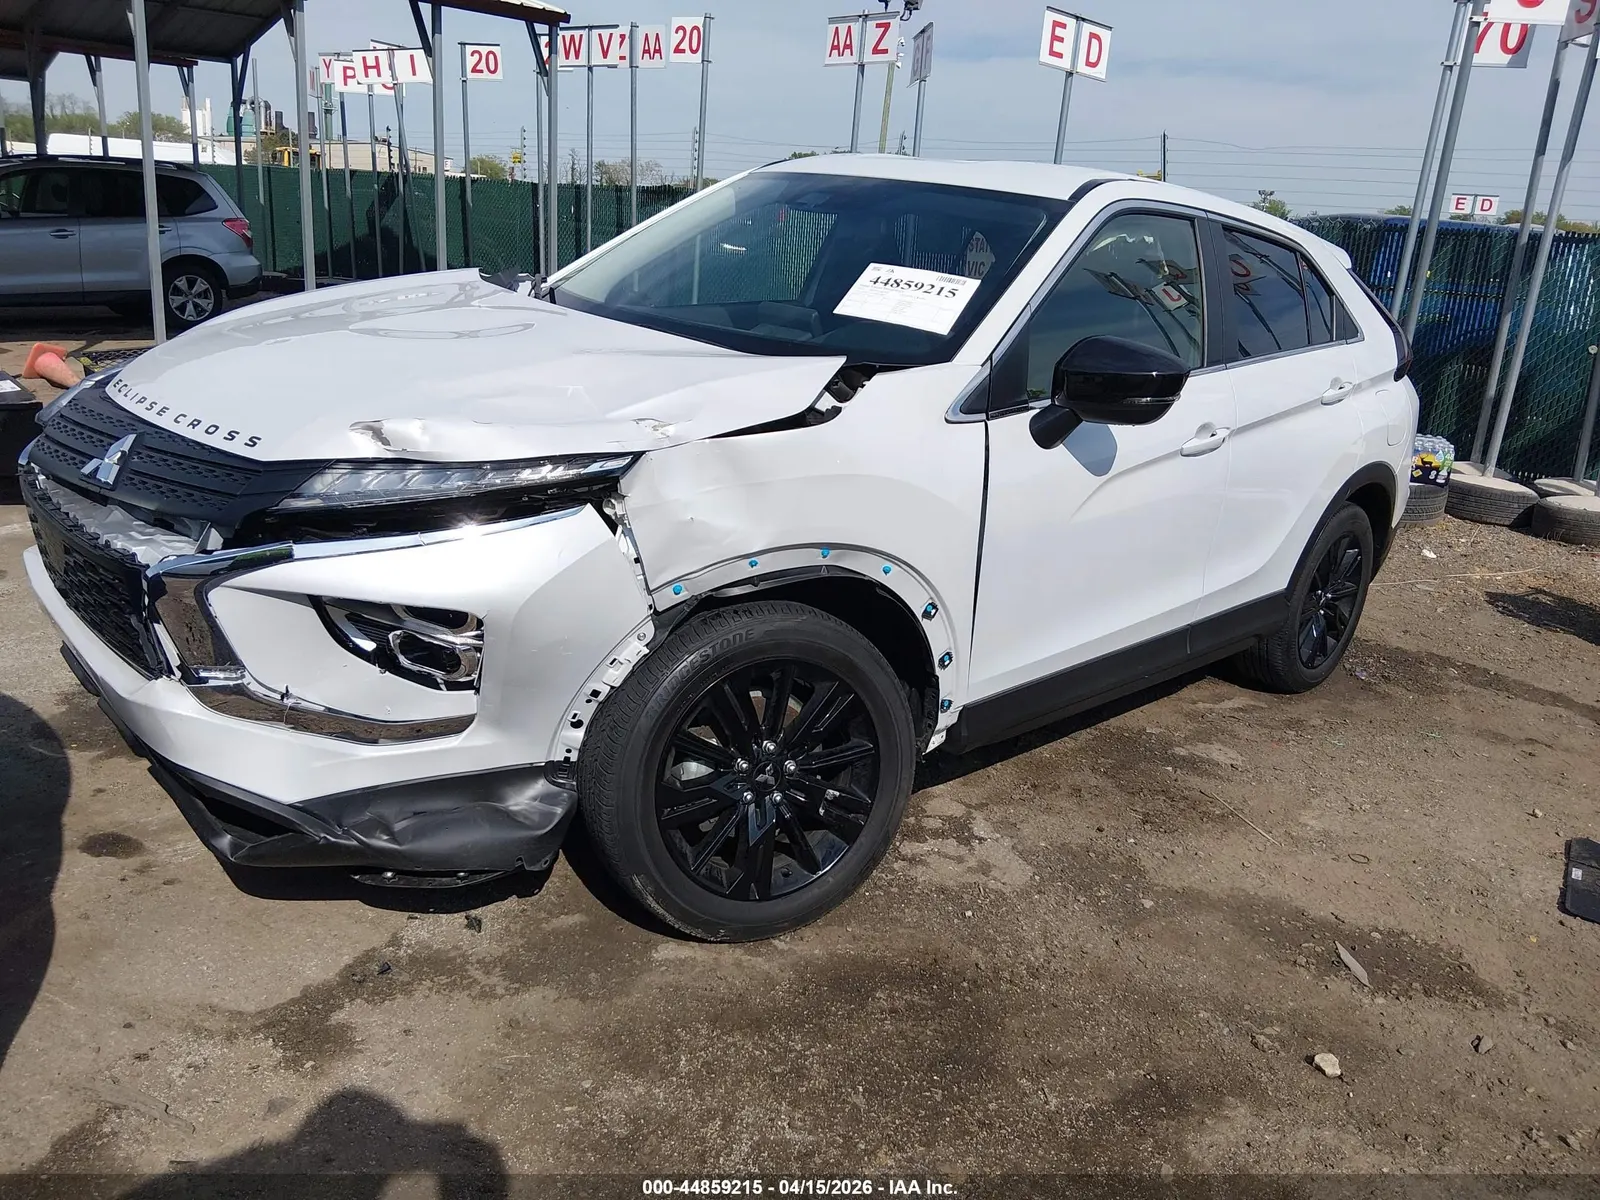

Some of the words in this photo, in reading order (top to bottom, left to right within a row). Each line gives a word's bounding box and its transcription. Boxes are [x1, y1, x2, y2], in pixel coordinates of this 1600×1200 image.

[561, 34, 584, 60] W
[597, 32, 614, 60] V
[641, 32, 663, 61] AA
[672, 25, 702, 55] 20
[828, 24, 854, 58] AA
[871, 22, 891, 55] Z
[1048, 19, 1067, 59] E
[1085, 31, 1103, 69] D
[322, 58, 332, 79] Y
[361, 55, 382, 78] H
[409, 53, 417, 77] I
[470, 49, 499, 75] 20
[342, 65, 357, 87] P
[1454, 197, 1467, 211] E
[1479, 198, 1493, 212] D
[869, 275, 959, 299] 44859215
[112, 378, 170, 417] ECLIPSE
[173, 413, 262, 448] CROSS
